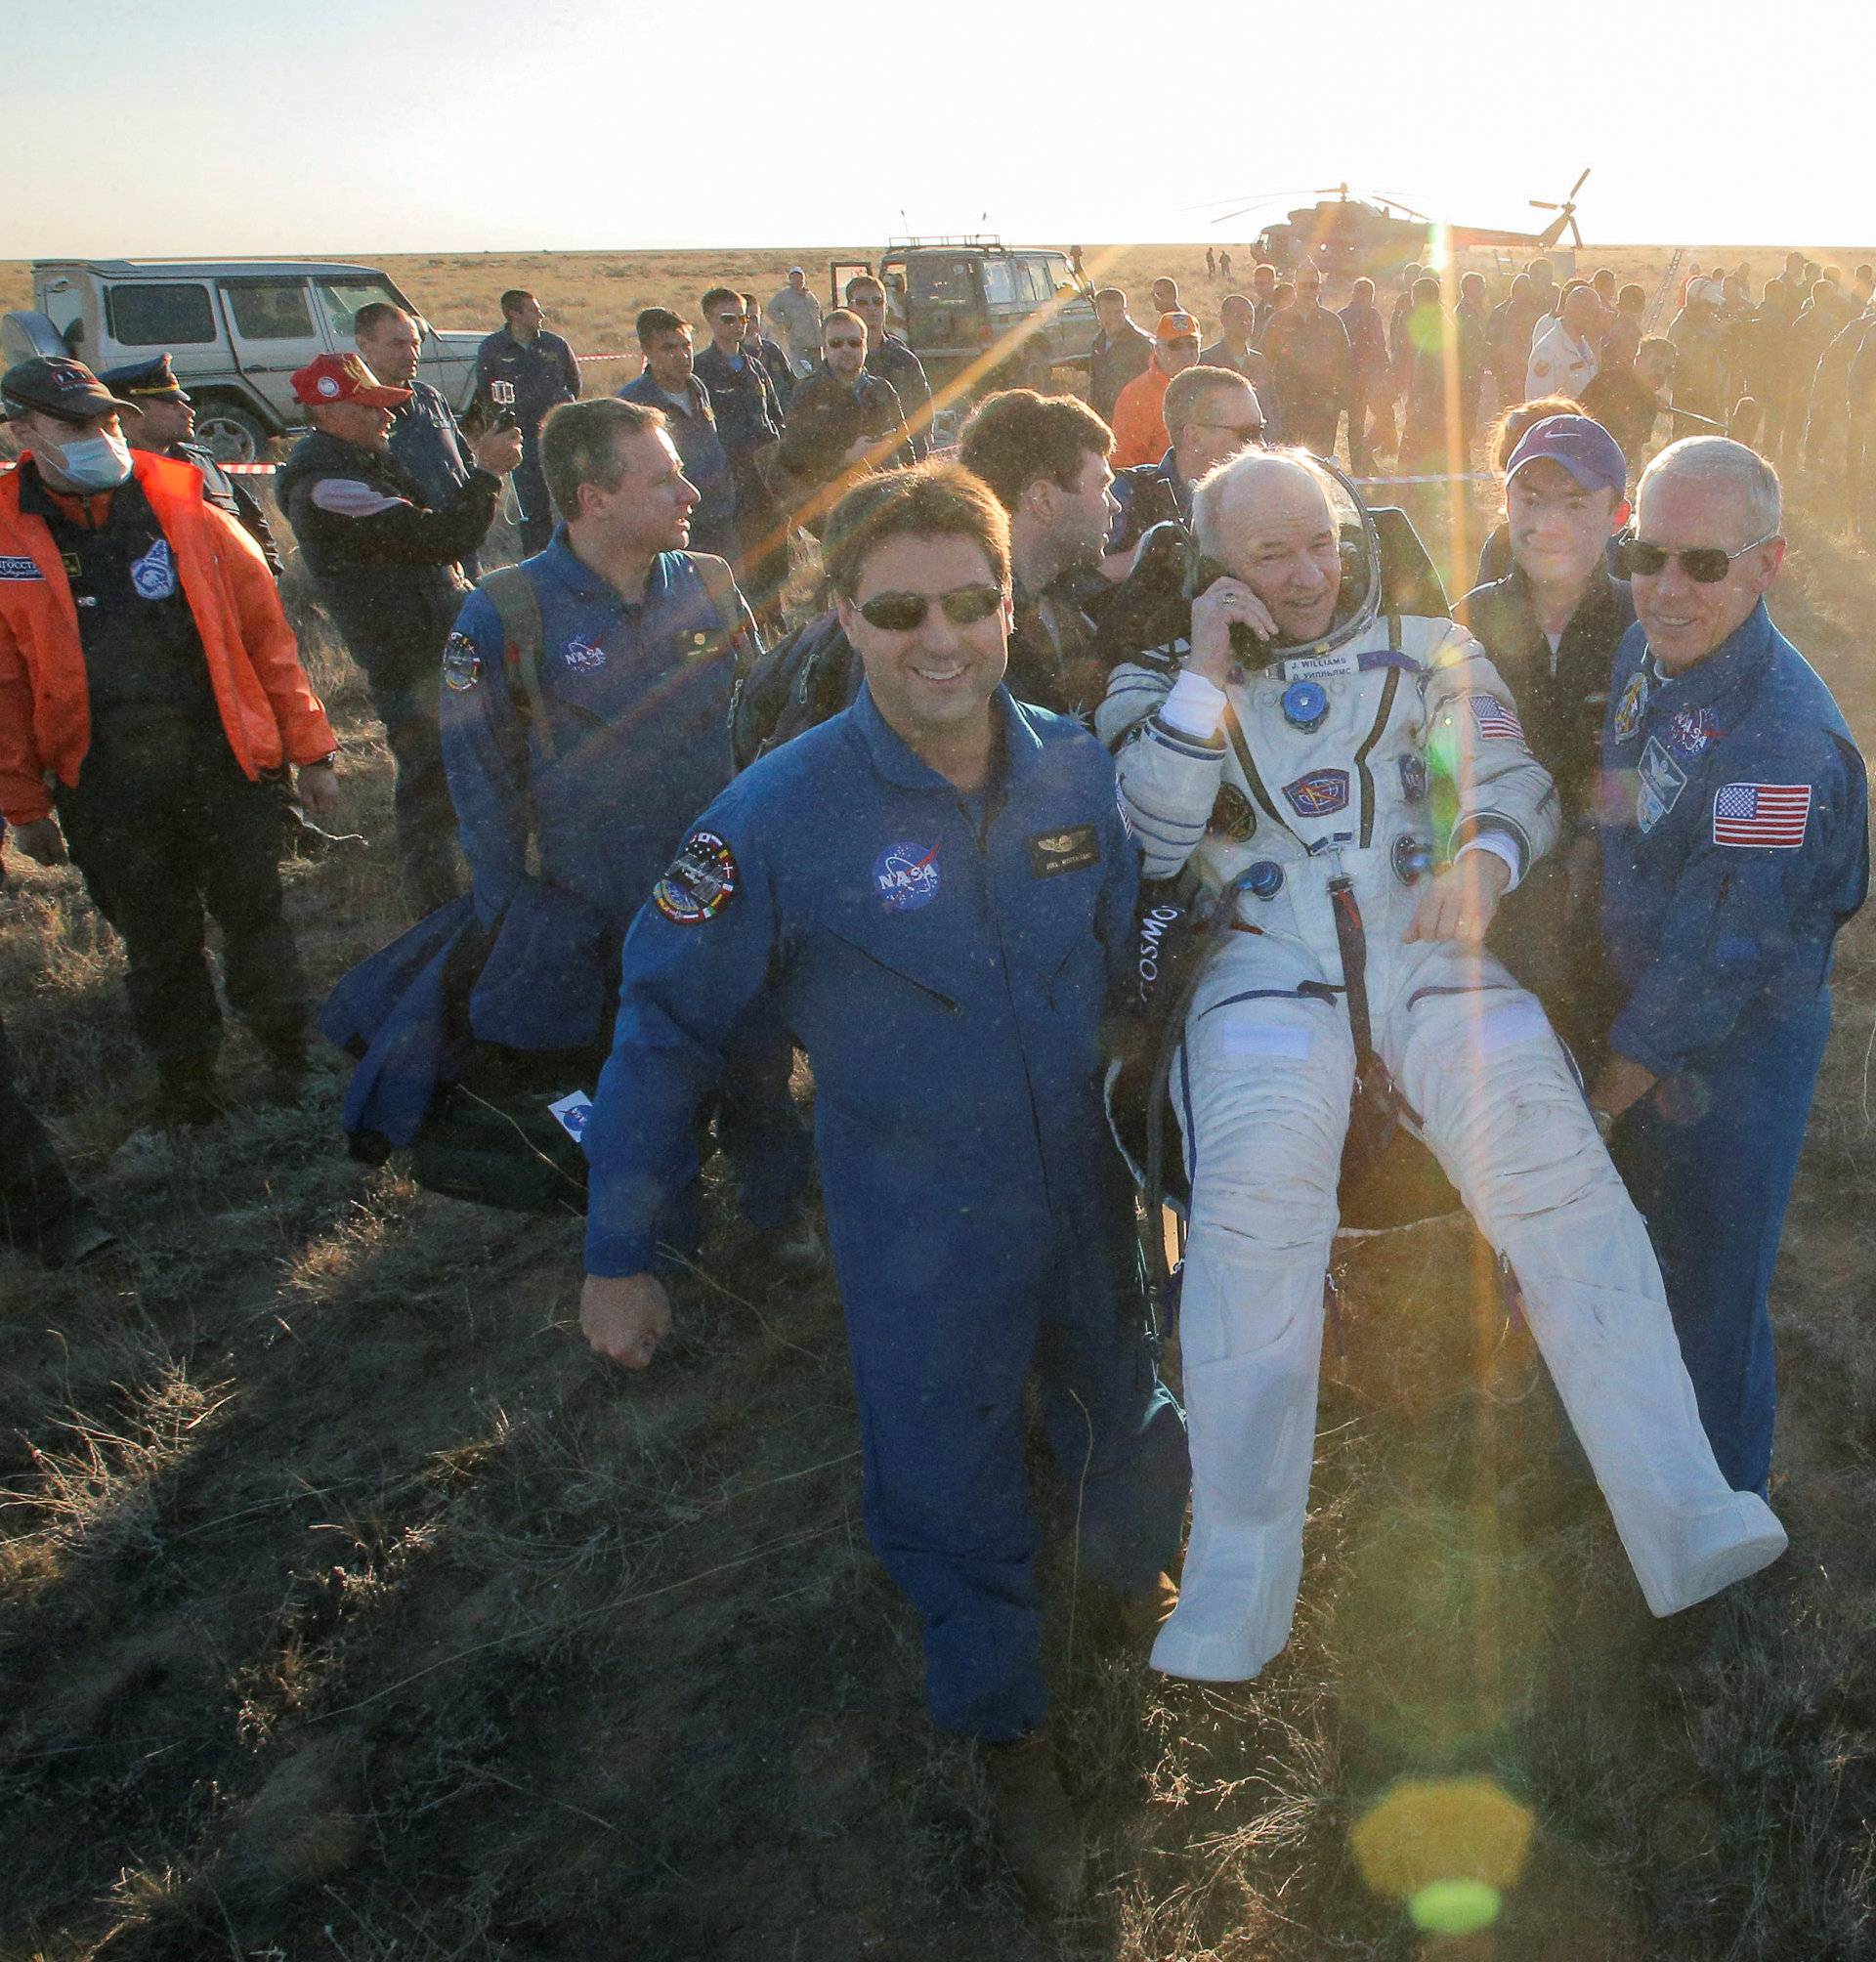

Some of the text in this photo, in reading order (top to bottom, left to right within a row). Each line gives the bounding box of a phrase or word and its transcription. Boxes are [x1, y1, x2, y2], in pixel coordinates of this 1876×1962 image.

[565, 647, 606, 665] NASA
[1300, 657, 1346, 668] WILLIAMS
[878, 864, 938, 890] NASA
